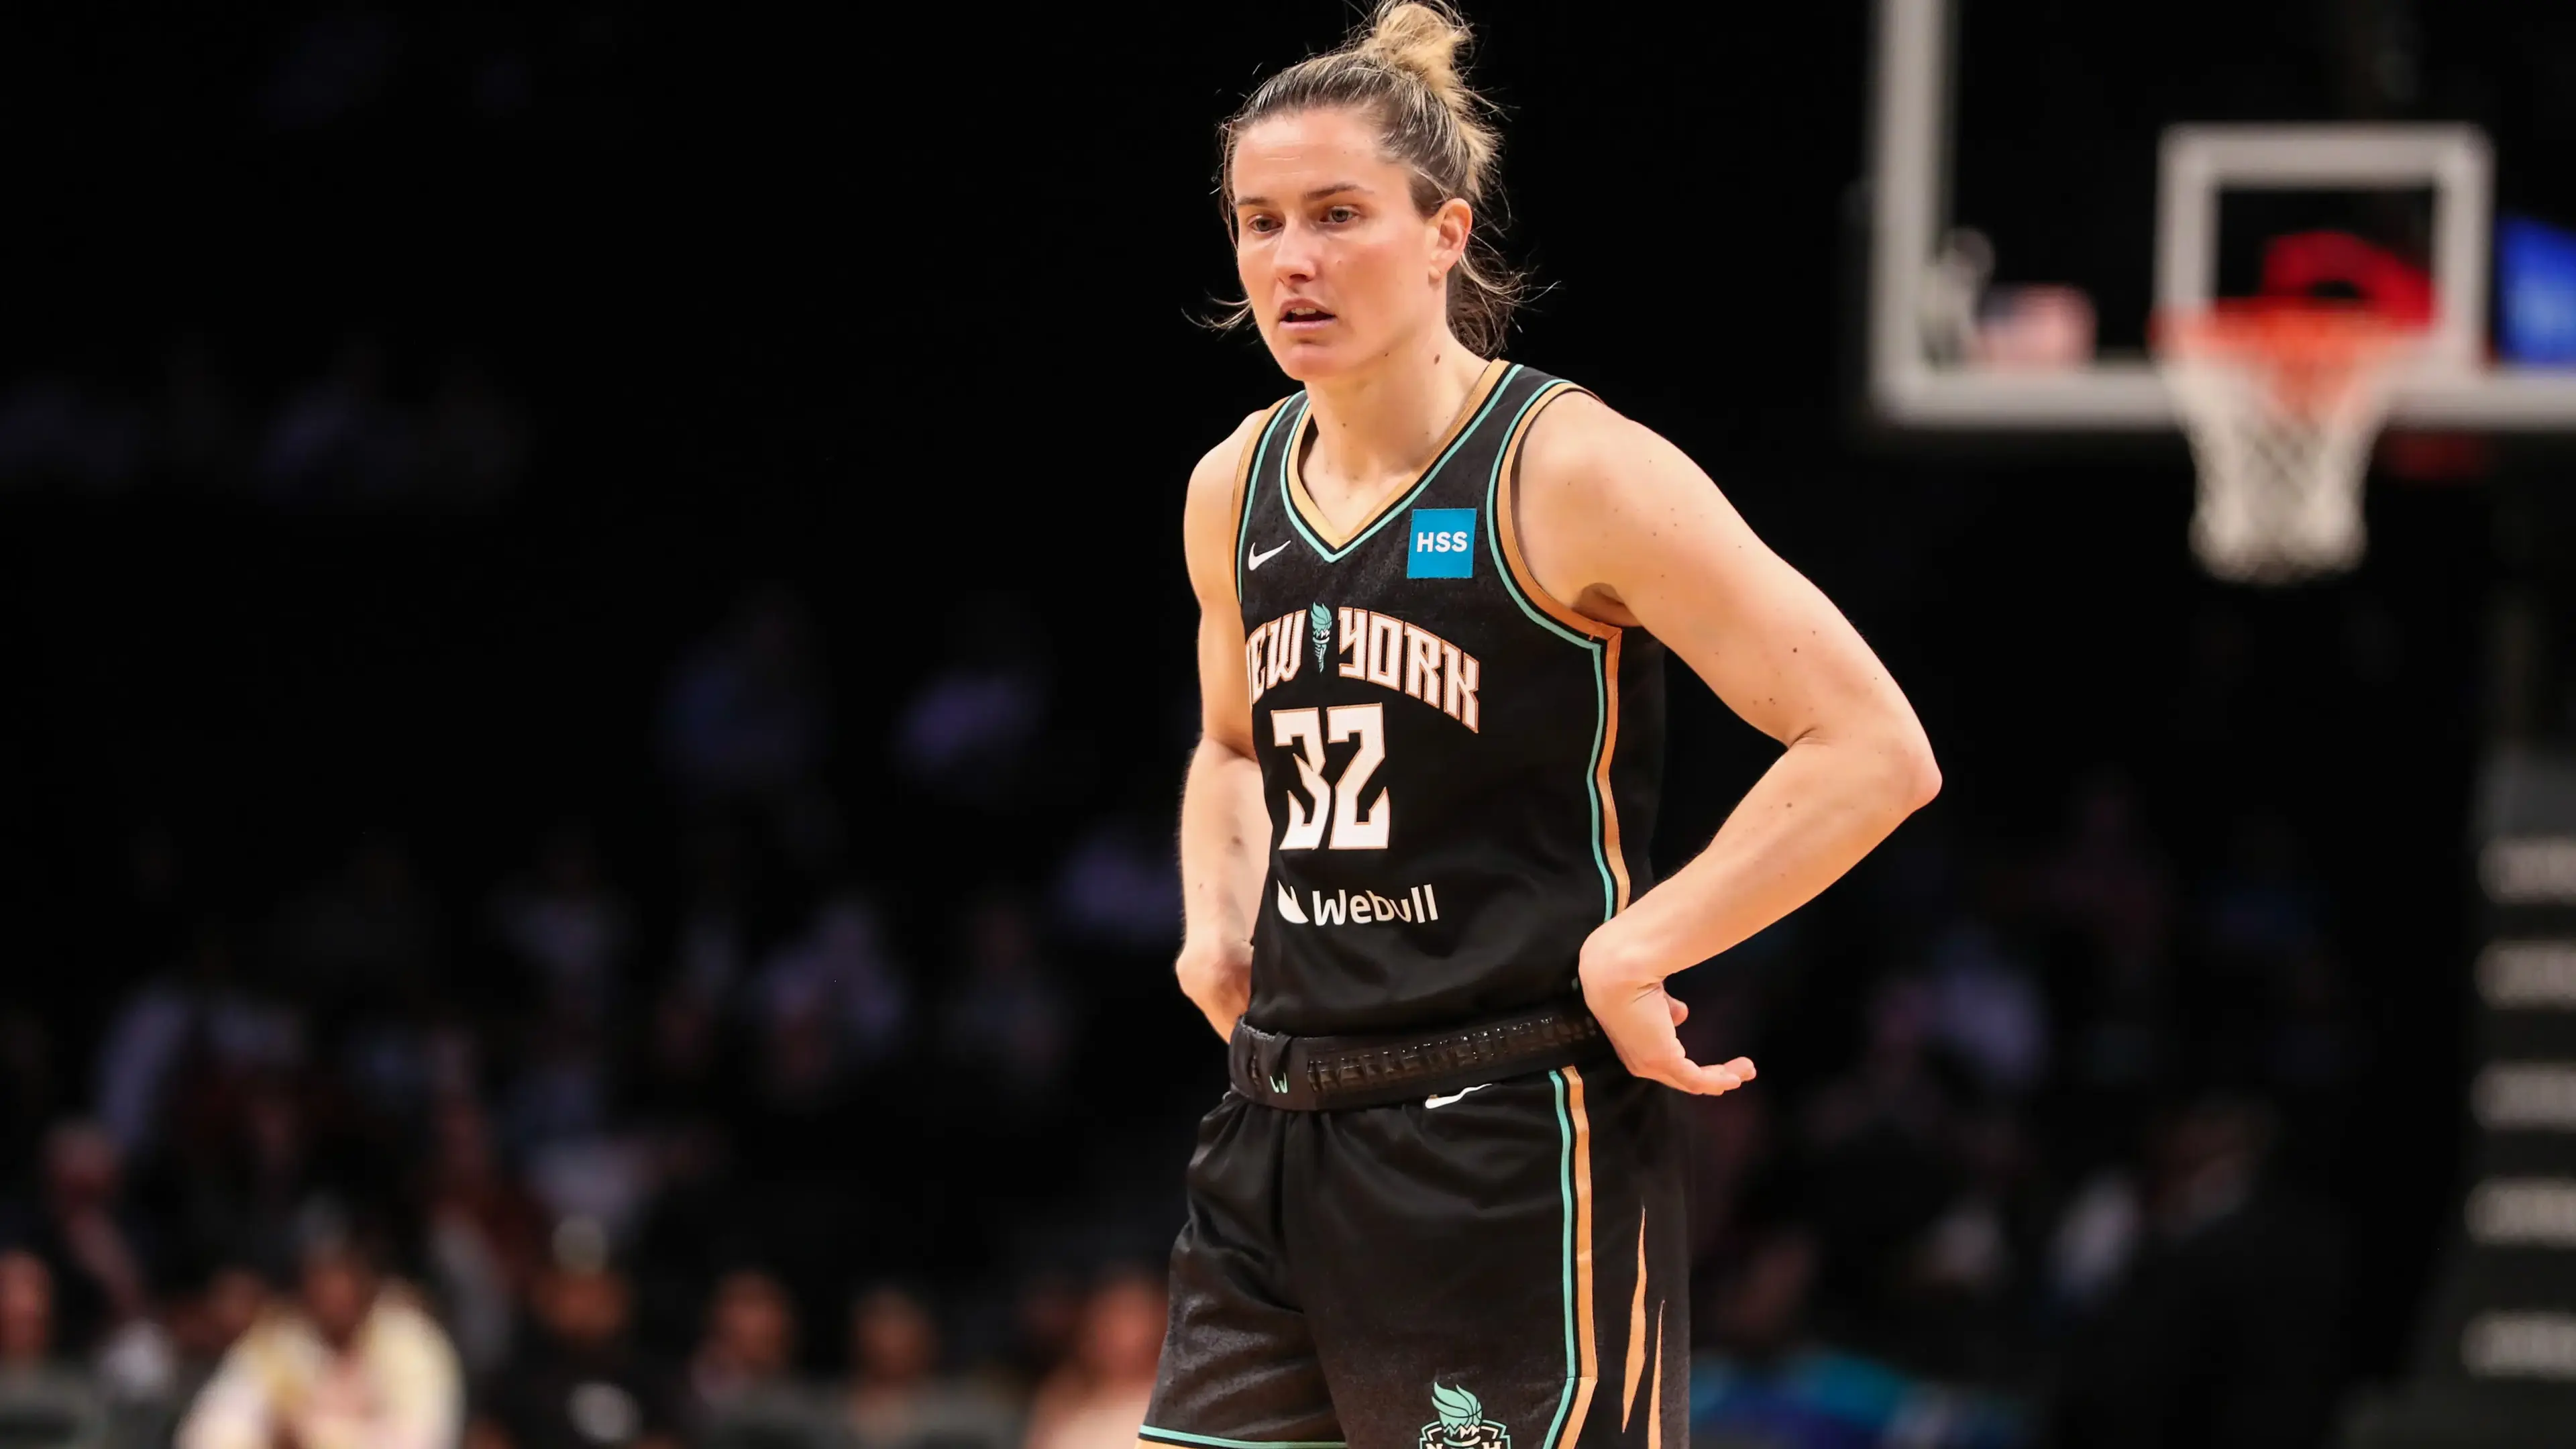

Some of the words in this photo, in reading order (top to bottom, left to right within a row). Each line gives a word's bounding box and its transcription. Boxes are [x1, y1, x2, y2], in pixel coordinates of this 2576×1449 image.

[1415, 531, 1468, 553] HSS
[1338, 606, 1480, 733] YORK
[1270, 702, 1391, 851] 32
[1312, 883, 1439, 926] Webull
